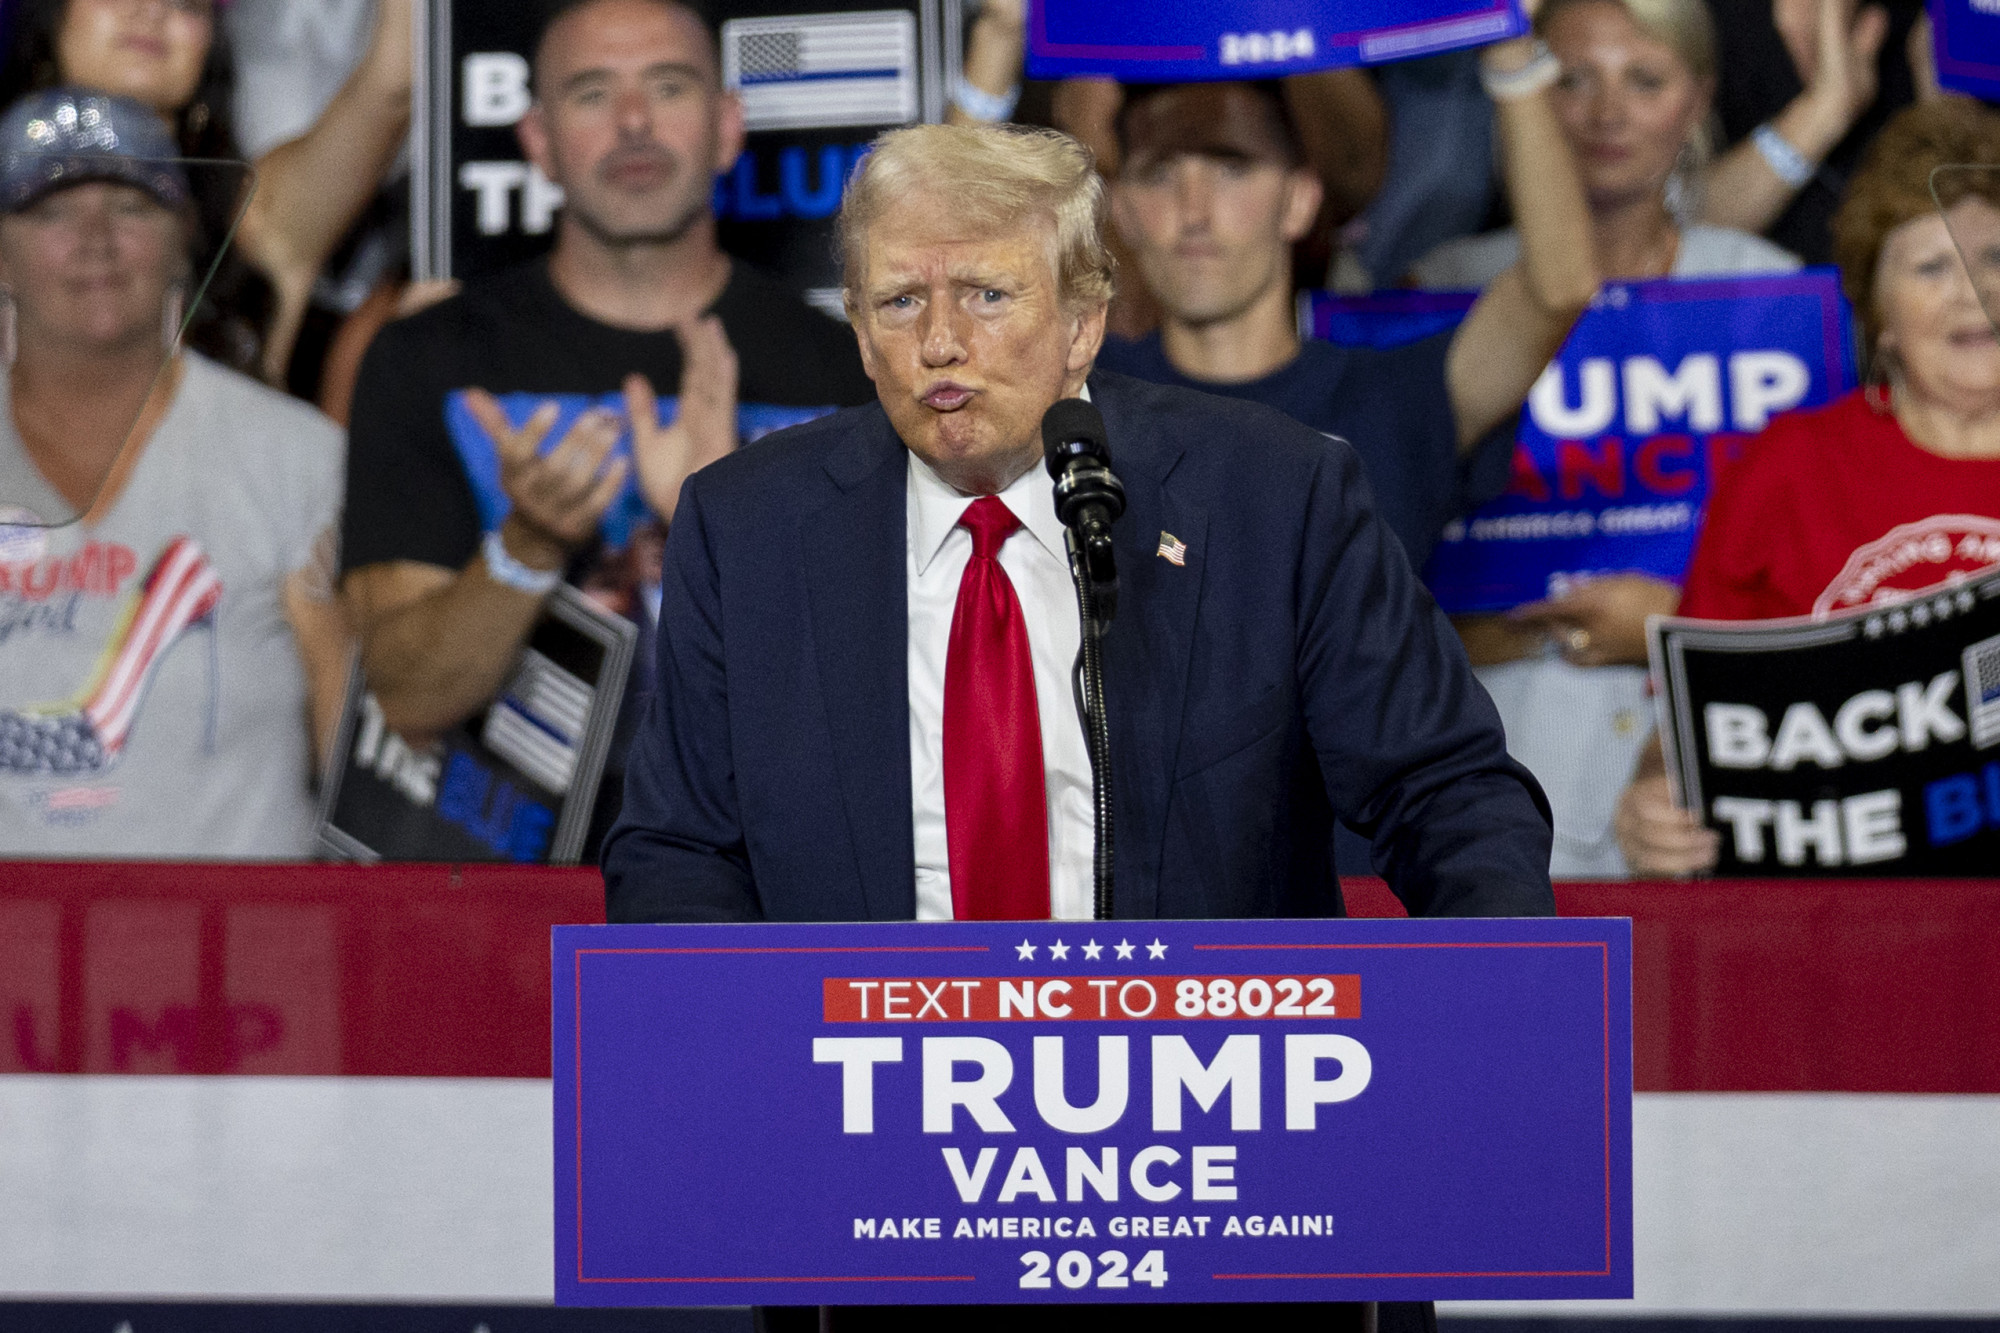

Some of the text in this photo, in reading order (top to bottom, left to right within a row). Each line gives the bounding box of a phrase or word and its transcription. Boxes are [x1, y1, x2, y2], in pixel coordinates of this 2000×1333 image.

[1528, 351, 1811, 438] UMP
[1704, 672, 1964, 769] BACK
[1712, 788, 1907, 866] THE
[849, 978, 1336, 1019] TEXT NC TO 88022
[812, 1034, 1372, 1134] TRUMP
[941, 1145, 1238, 1203] VANCE
[853, 1215, 1334, 1239] MAKE AMERICA GREAT AGAIN!
[1019, 1250, 1169, 1289] 2024
